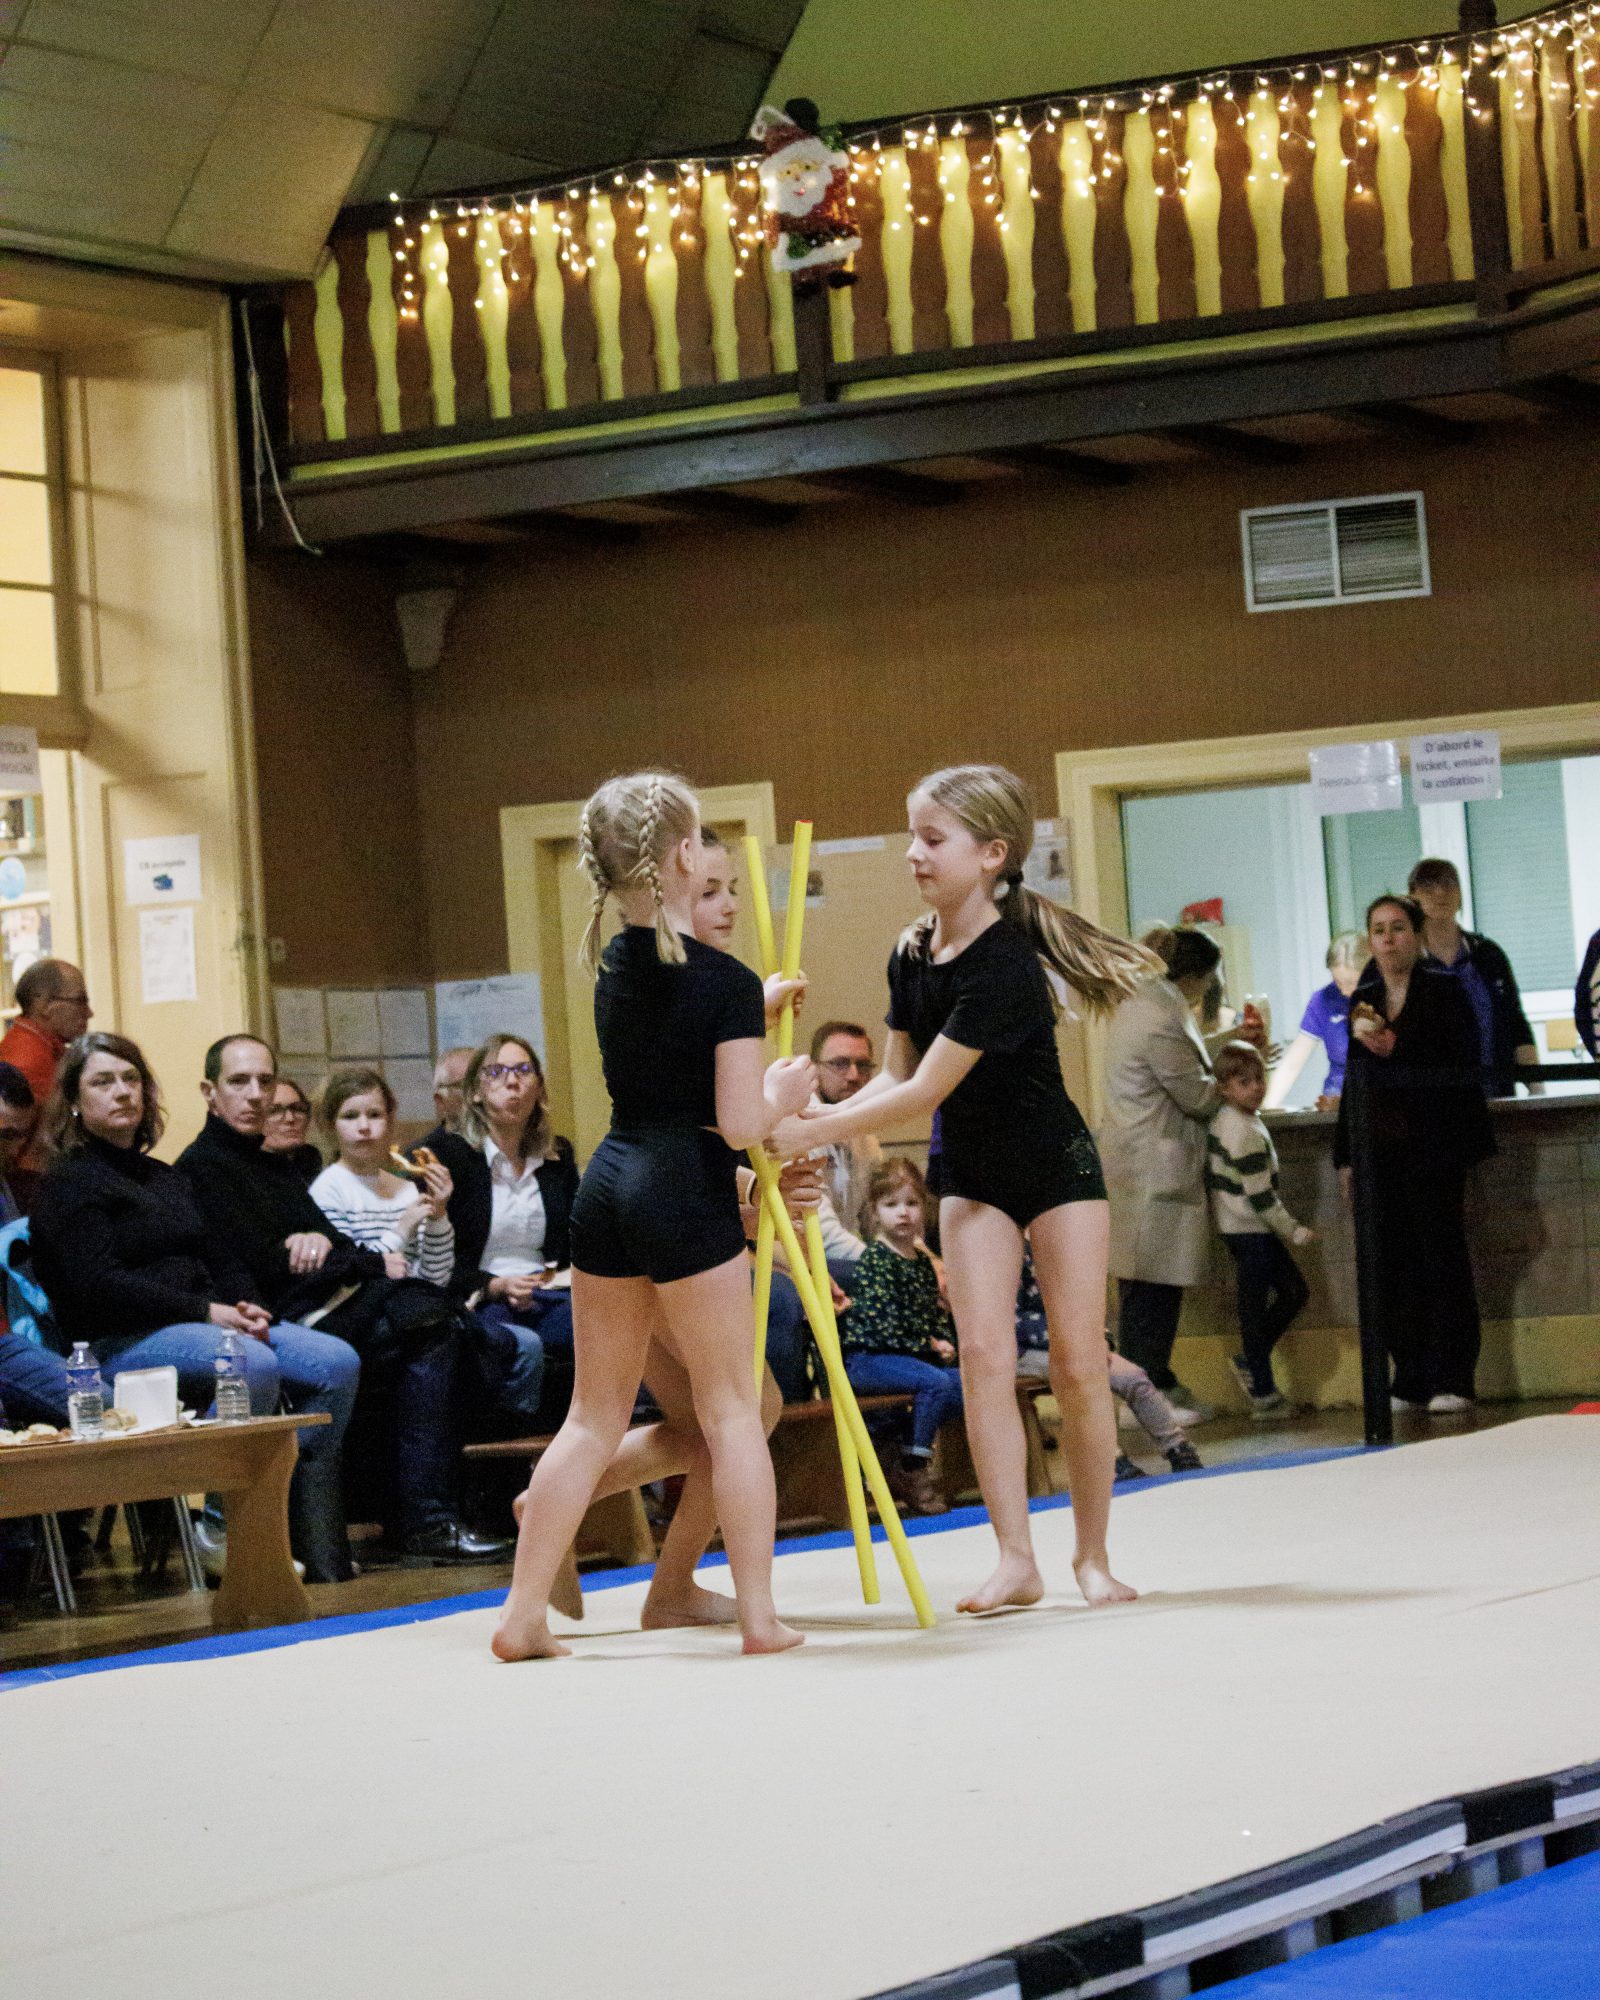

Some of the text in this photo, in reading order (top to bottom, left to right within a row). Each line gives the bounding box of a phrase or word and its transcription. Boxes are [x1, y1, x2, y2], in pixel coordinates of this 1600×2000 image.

[1425, 738, 1484, 753] D'abord le
[1416, 757, 1495, 771] ticket, ensuite
[1422, 779, 1433, 788] la
[1436, 776, 1484, 788] collation
